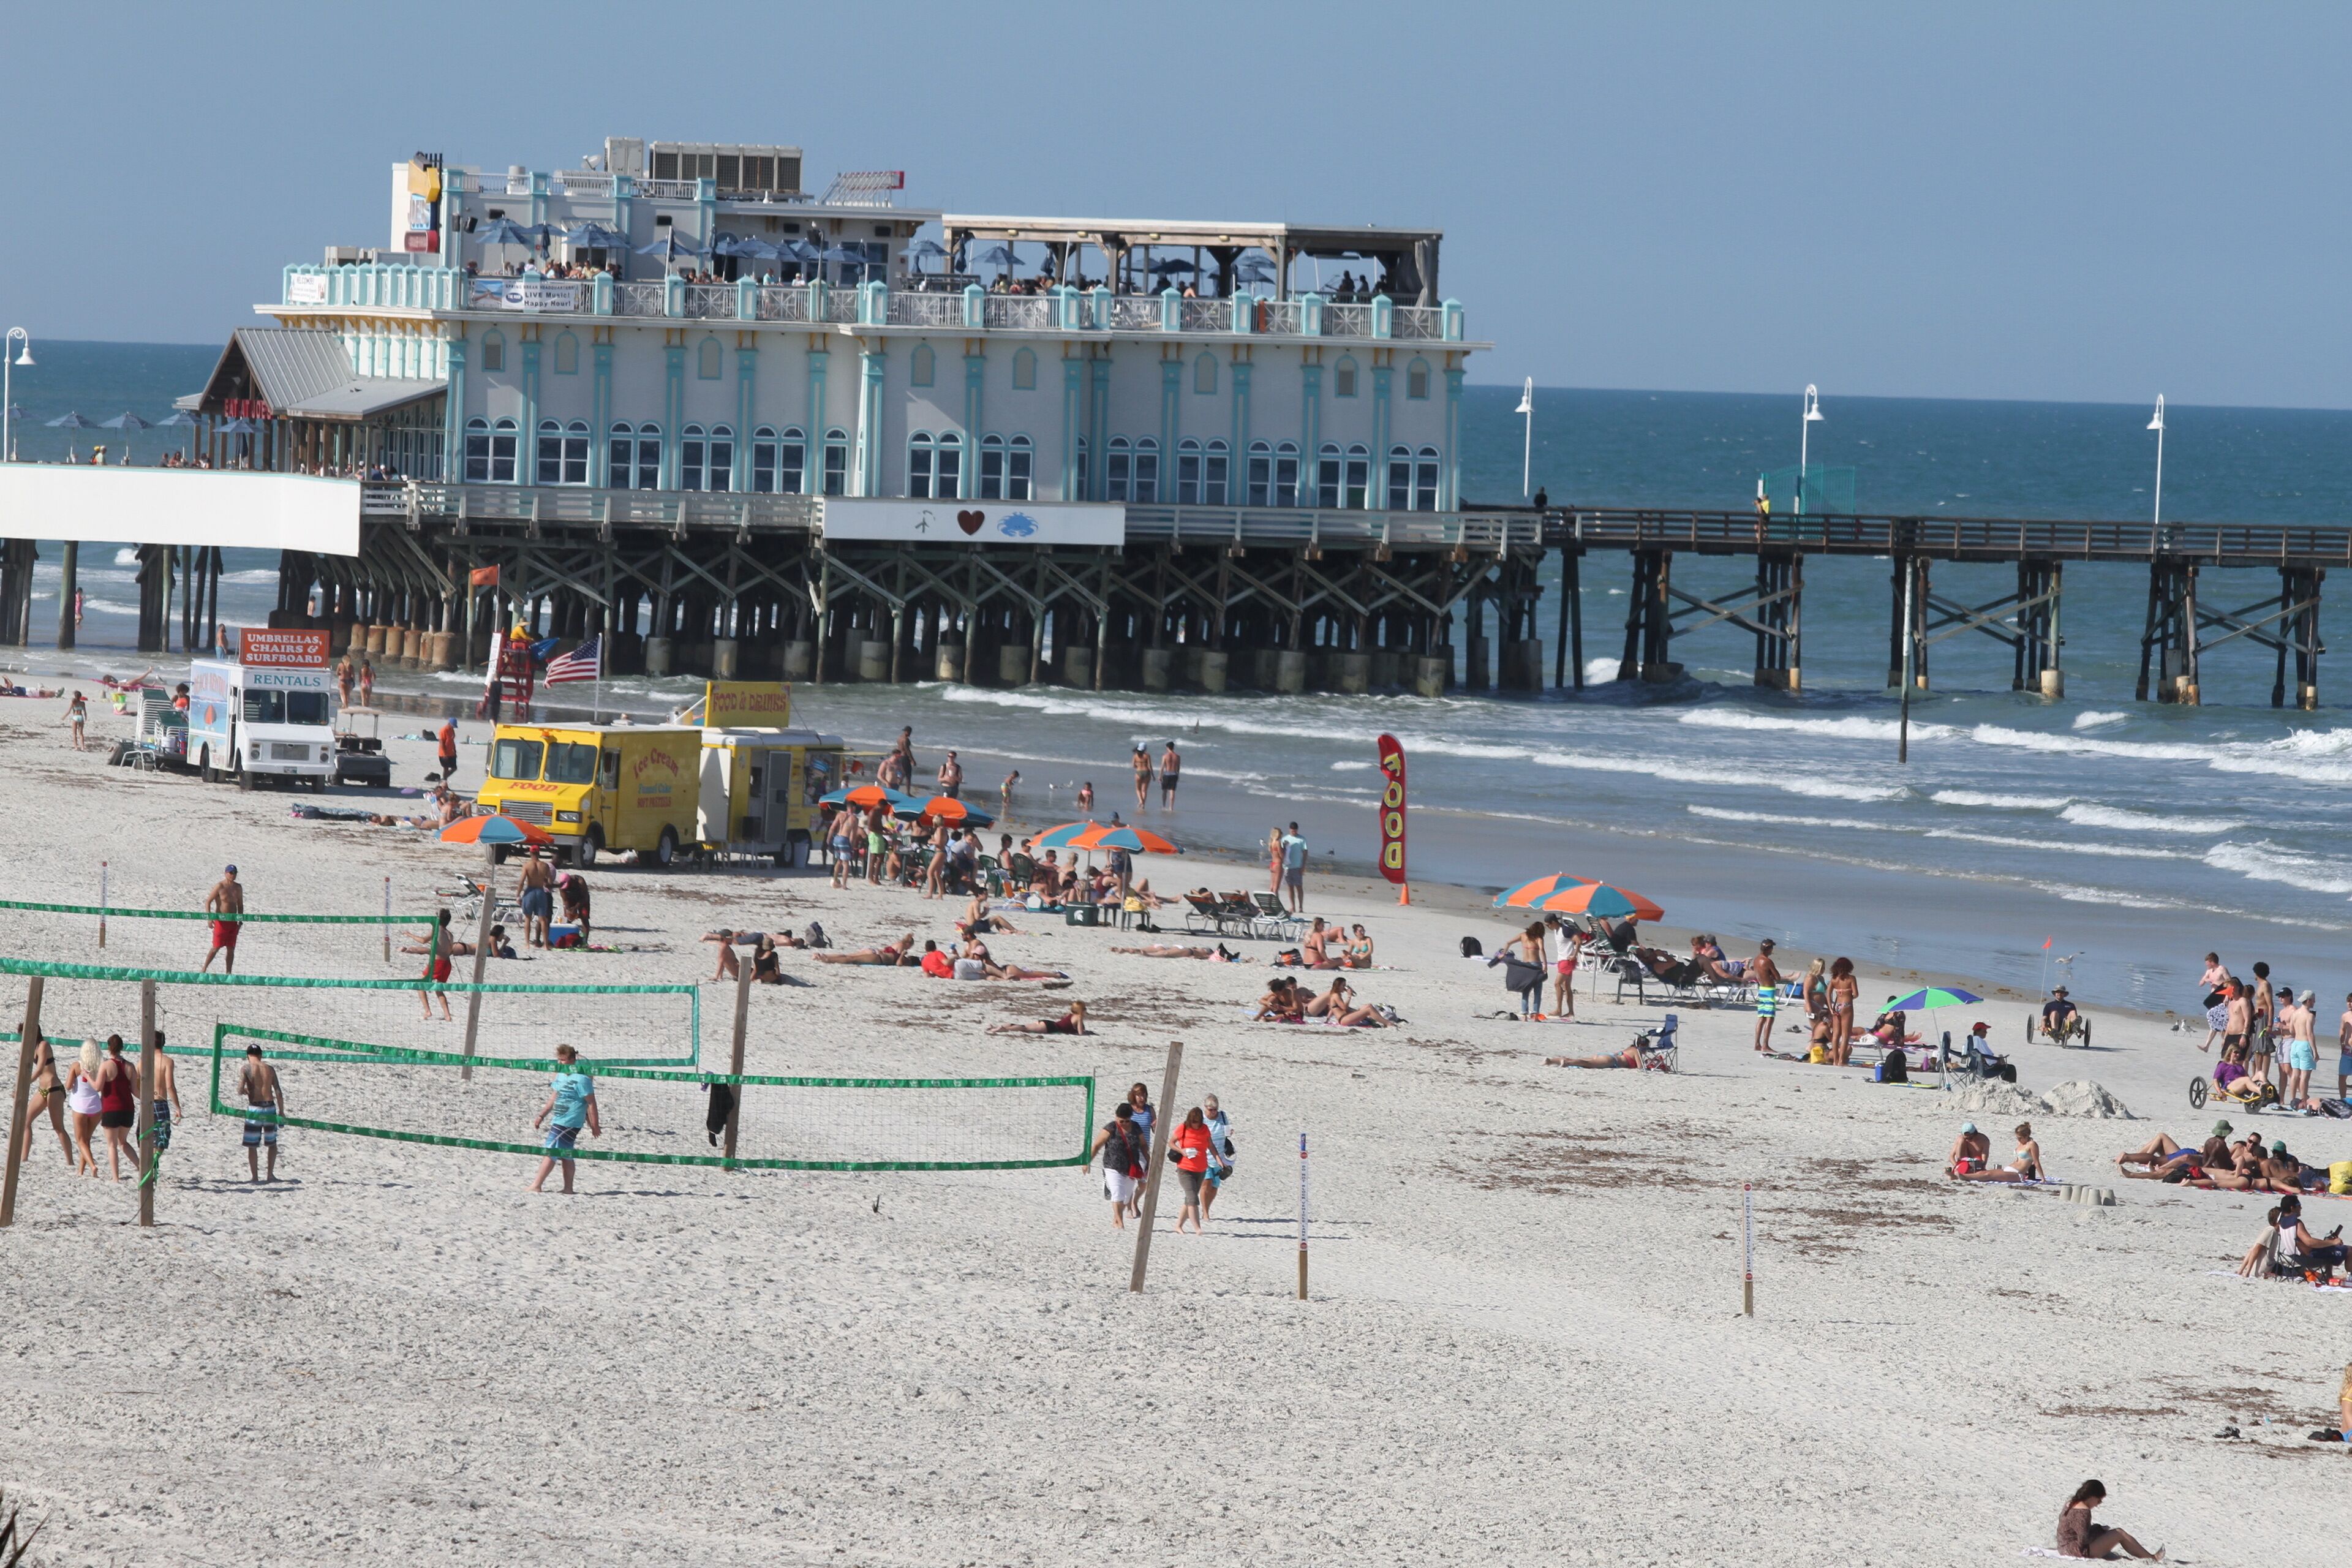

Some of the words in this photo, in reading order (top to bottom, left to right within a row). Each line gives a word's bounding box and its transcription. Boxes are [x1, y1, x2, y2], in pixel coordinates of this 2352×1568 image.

[225, 399, 238, 418] EAT
[241, 399, 250, 418] AT
[247, 633, 322, 645] UMBRELLAS,
[250, 644, 303, 653] CHAIRS
[246, 654, 322, 663] SURFBOARD
[254, 674, 321, 687] RENTALS
[713, 693, 737, 712] FOOD
[739, 691, 746, 710] &
[749, 693, 786, 712] DRINKS
[633, 755, 648, 779] Ice
[651, 748, 679, 777] Cream
[508, 782, 559, 791] FOOD
